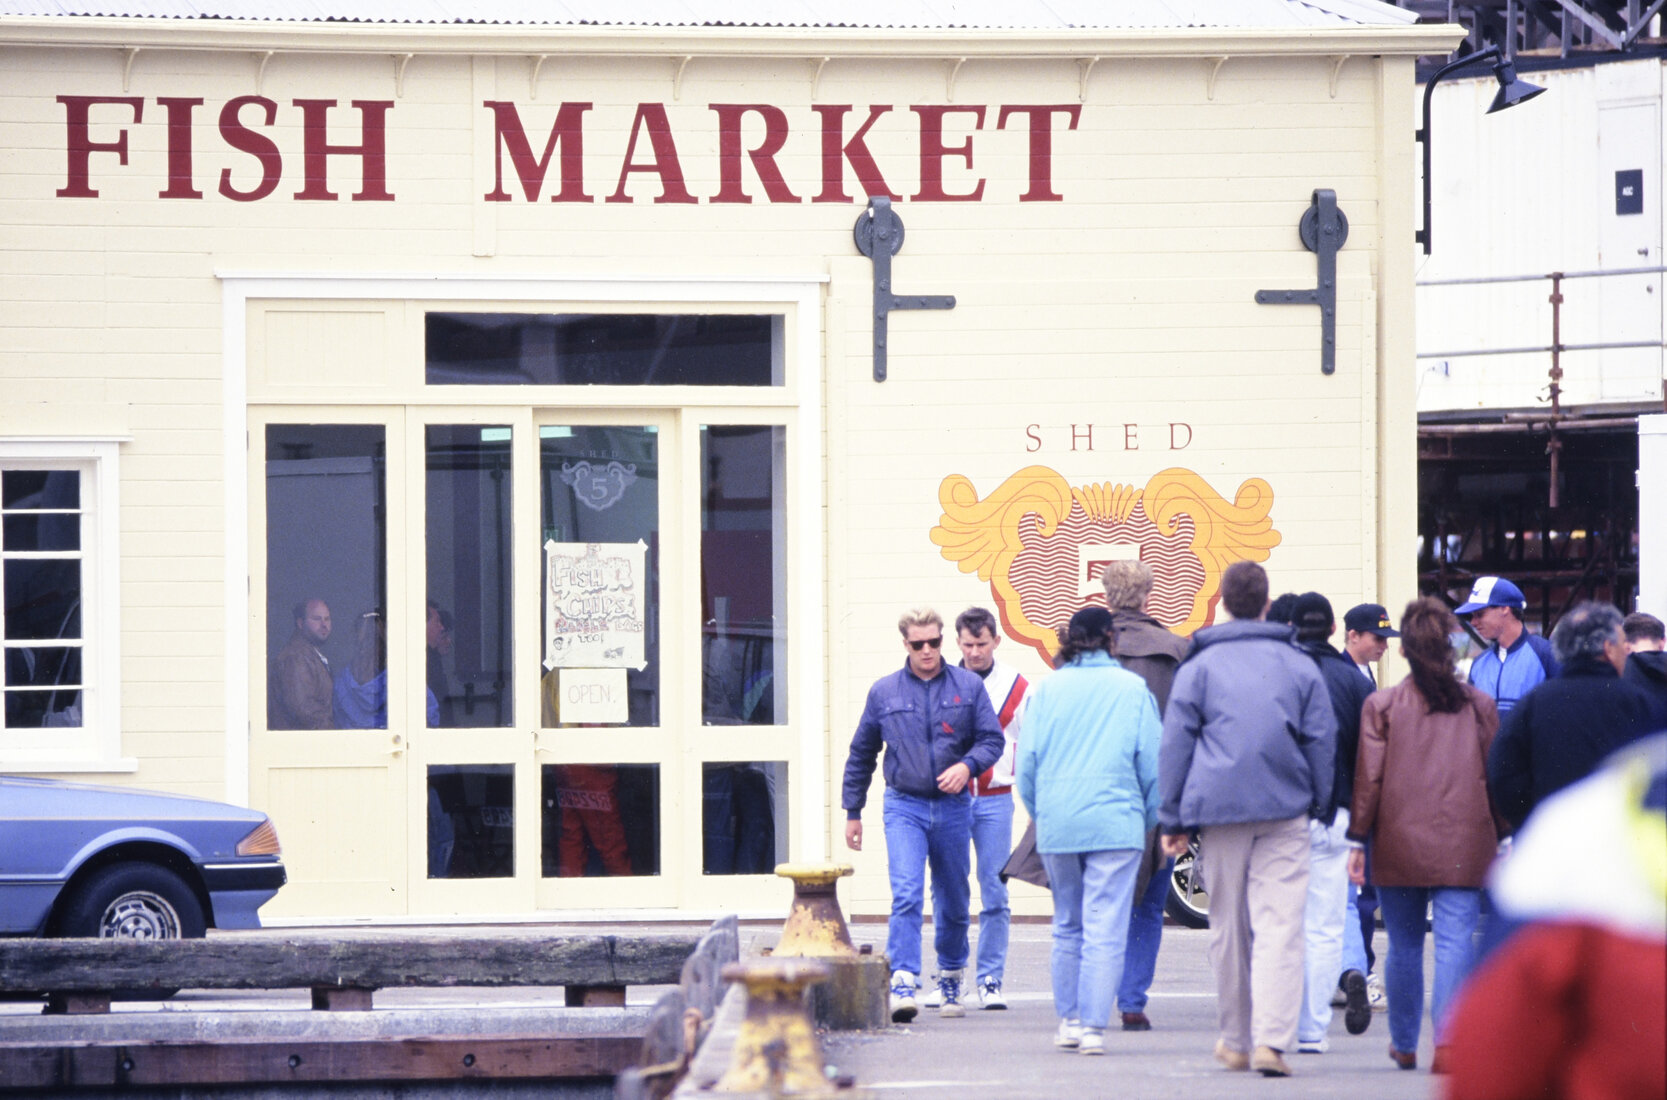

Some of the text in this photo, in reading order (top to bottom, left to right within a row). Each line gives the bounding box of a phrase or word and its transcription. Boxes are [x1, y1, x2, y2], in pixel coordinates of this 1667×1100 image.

[56, 95, 1082, 204] FISH MARKET
[1026, 423, 1193, 452] SHED
[591, 478, 608, 500] 5
[554, 561, 604, 588] FISH
